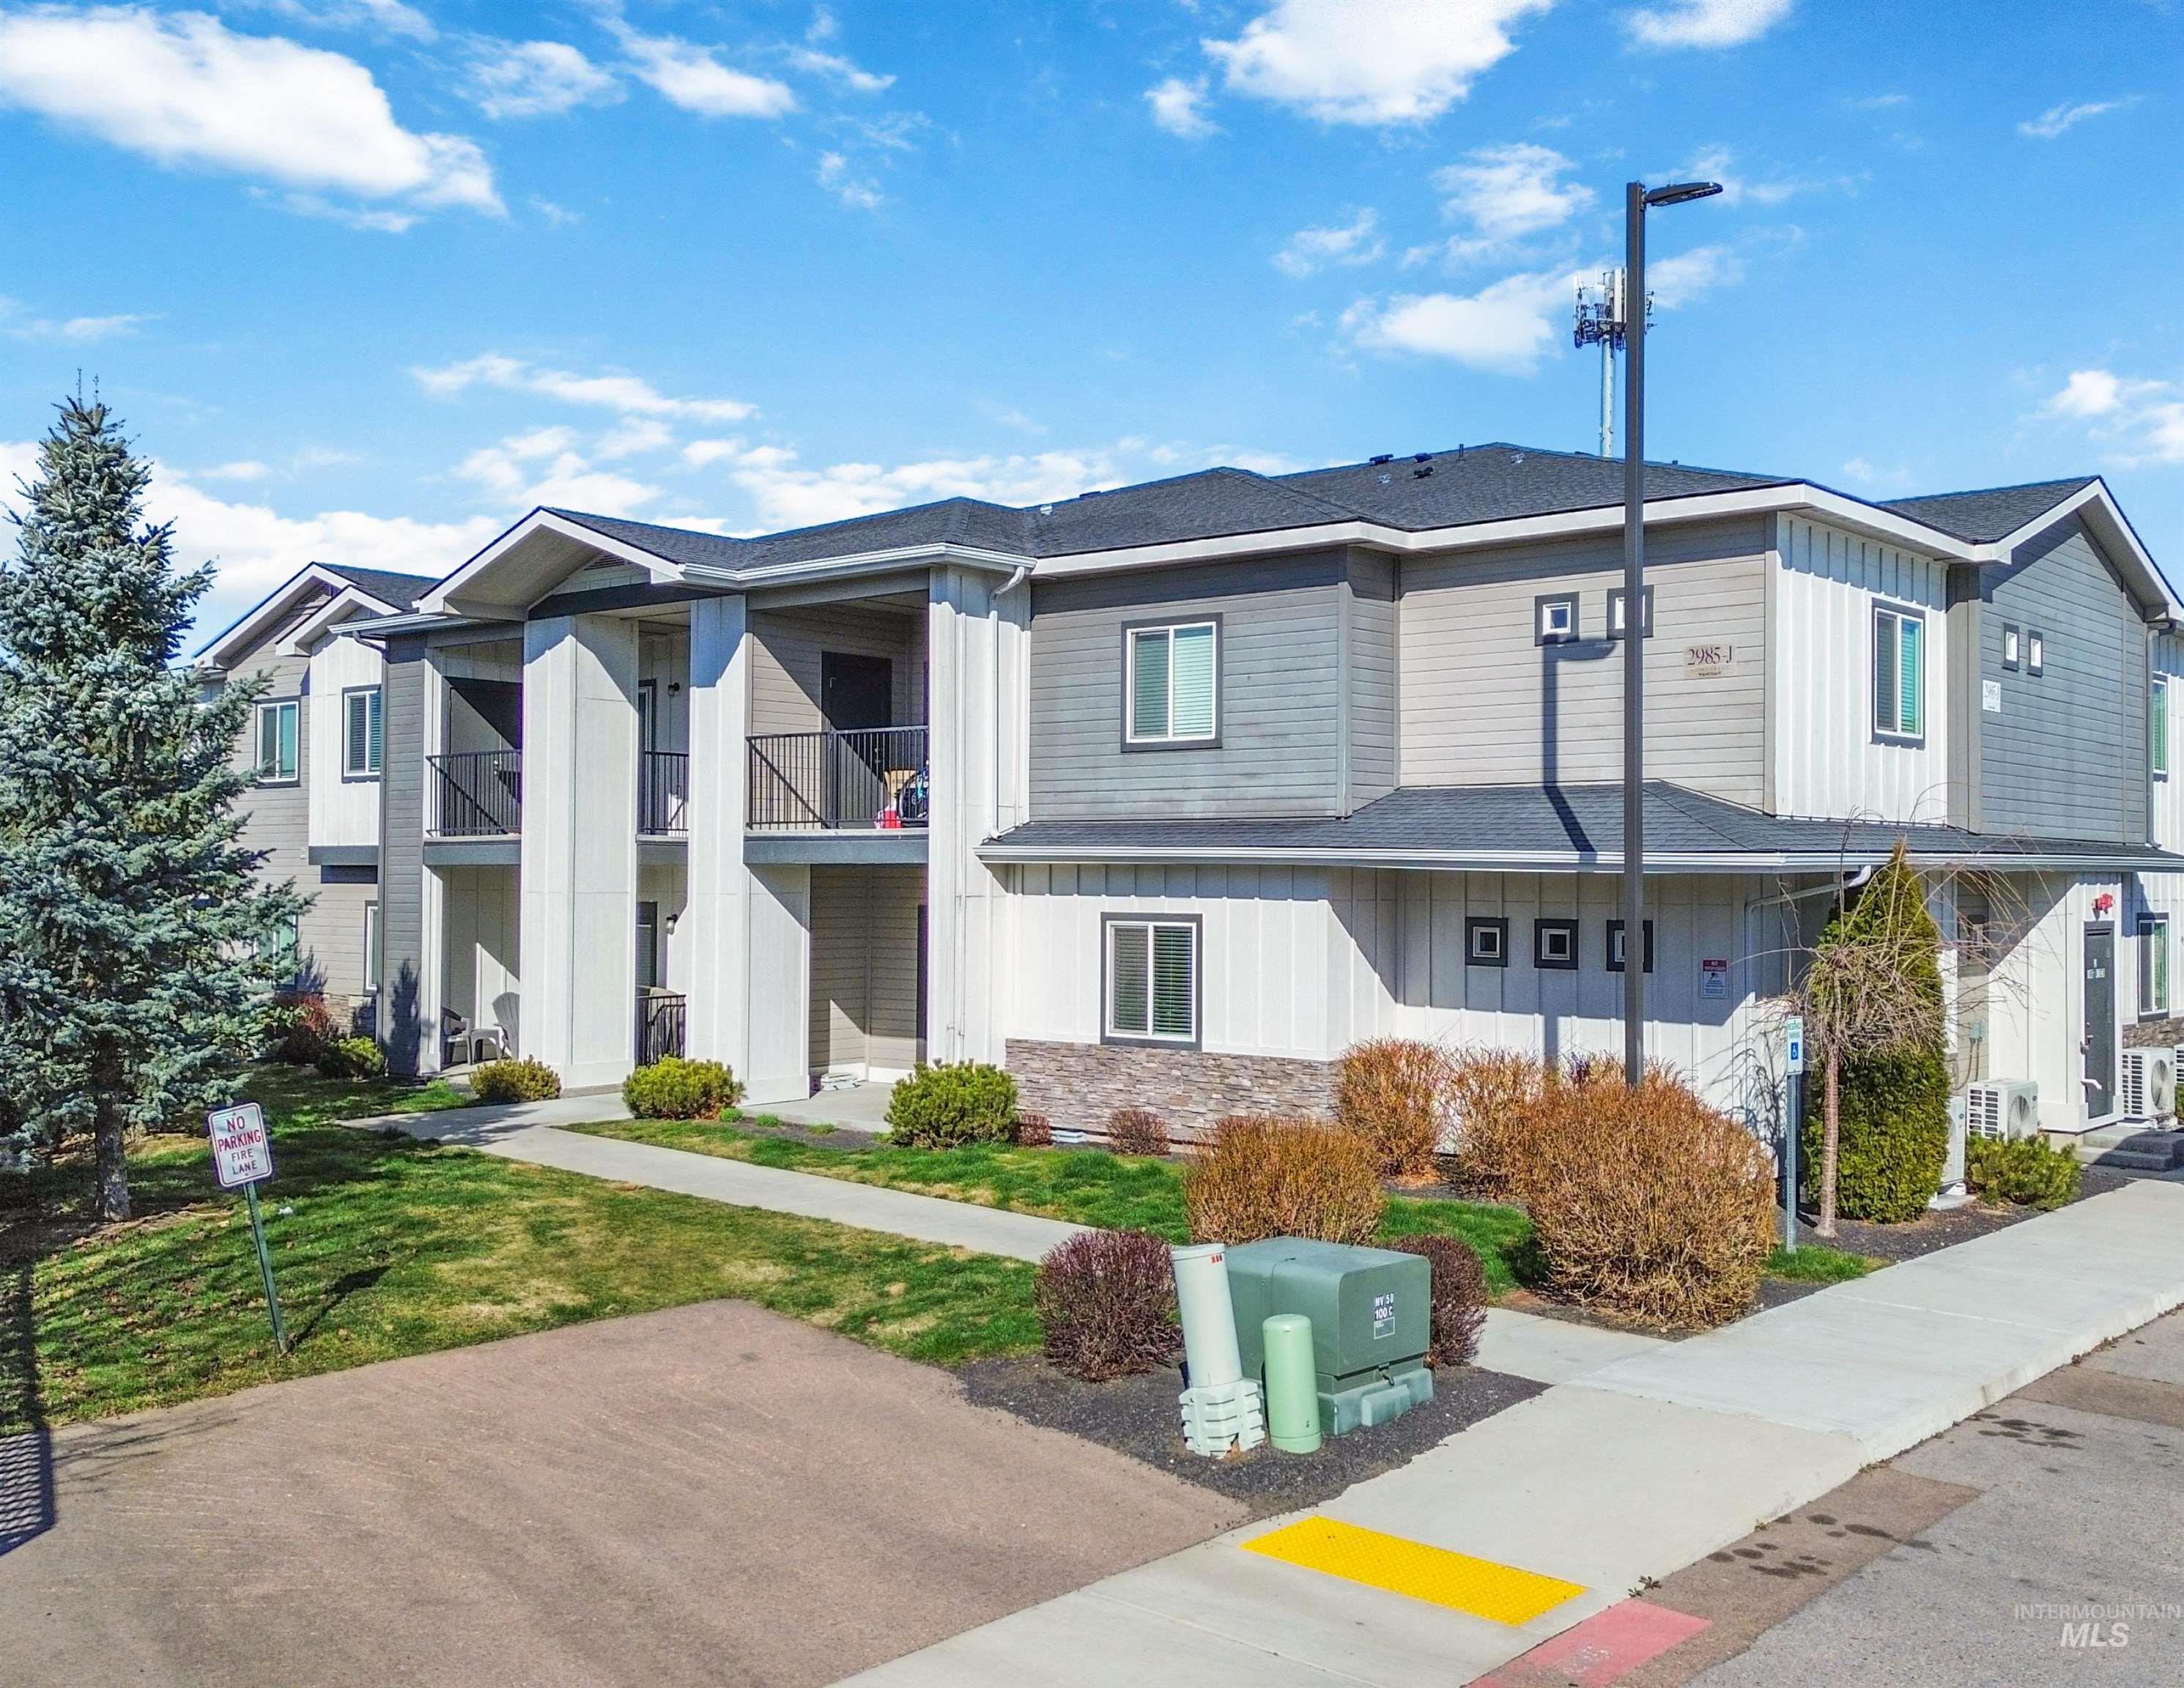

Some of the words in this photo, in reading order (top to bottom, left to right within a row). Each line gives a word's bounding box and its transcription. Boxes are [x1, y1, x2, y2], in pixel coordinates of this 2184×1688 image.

[1687, 645, 1732, 665] 2985-J
[226, 1116, 245, 1132] NO
[218, 1130, 261, 1152] PARKING
[232, 1149, 253, 1161] FIRE
[232, 1160, 257, 1174] LANE
[1374, 1308, 1387, 1319] 100
[1388, 1306, 1393, 1317] C
